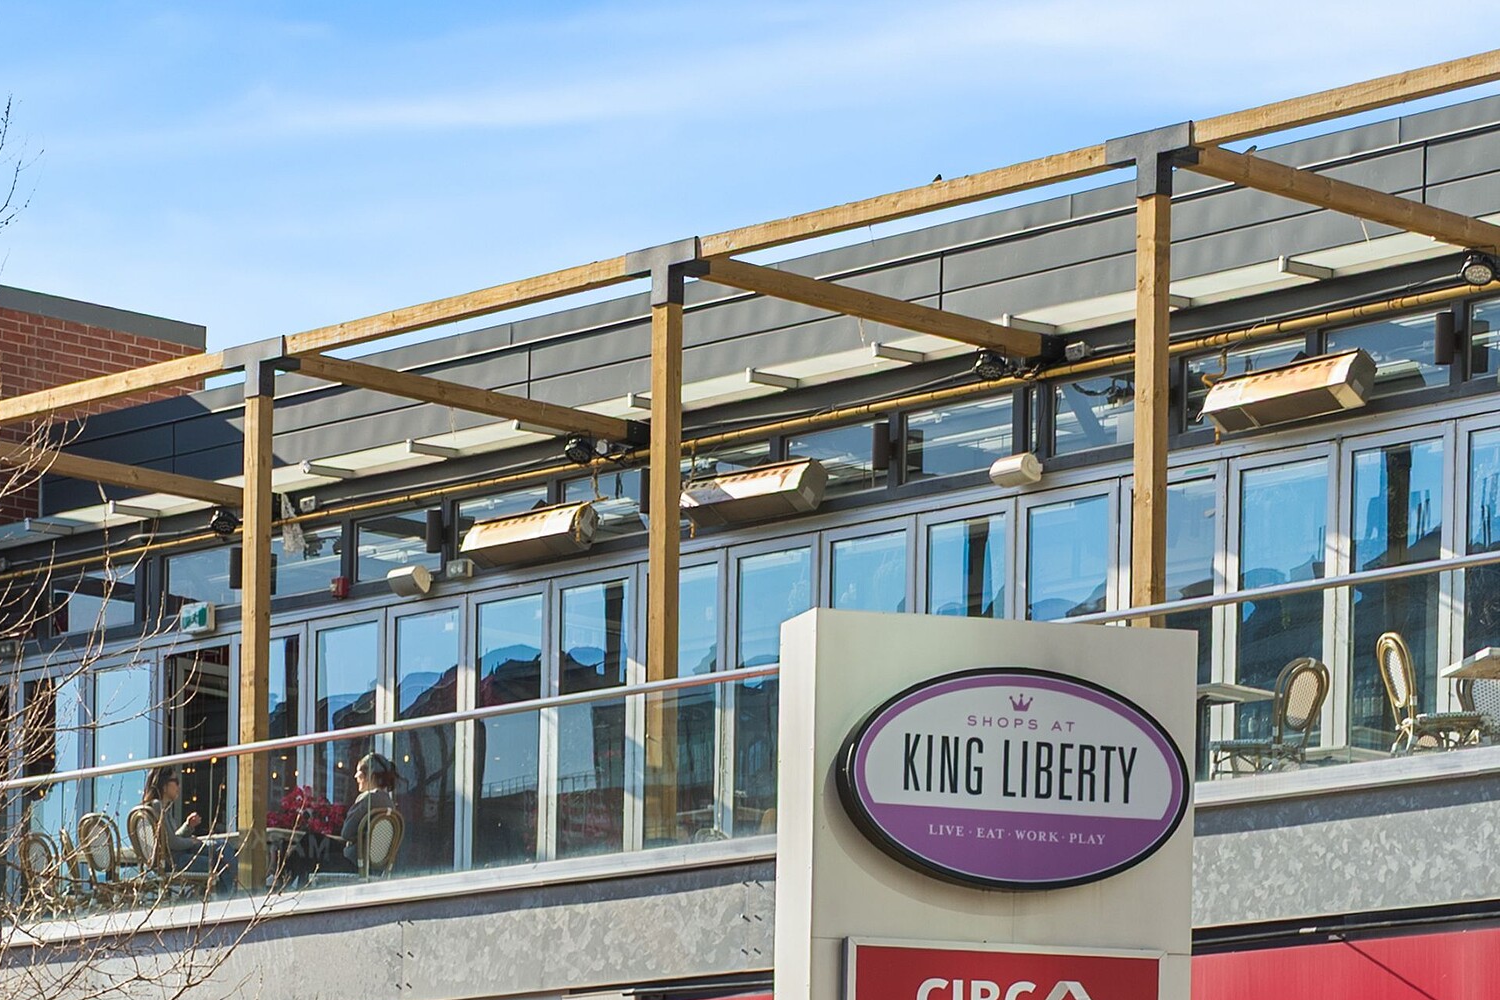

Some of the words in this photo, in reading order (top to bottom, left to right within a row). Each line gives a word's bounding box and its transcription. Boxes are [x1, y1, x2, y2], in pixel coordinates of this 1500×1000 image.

[967, 714, 1039, 731] SHOPS
[1051, 720, 1076, 733] AT
[902, 732, 985, 796] KING
[1002, 738, 1138, 805] LIBERTY
[928, 823, 964, 838] LIVE
[976, 826, 1005, 840] EAT
[1015, 828, 1059, 843] WORK
[1069, 832, 1106, 847] PLAY
